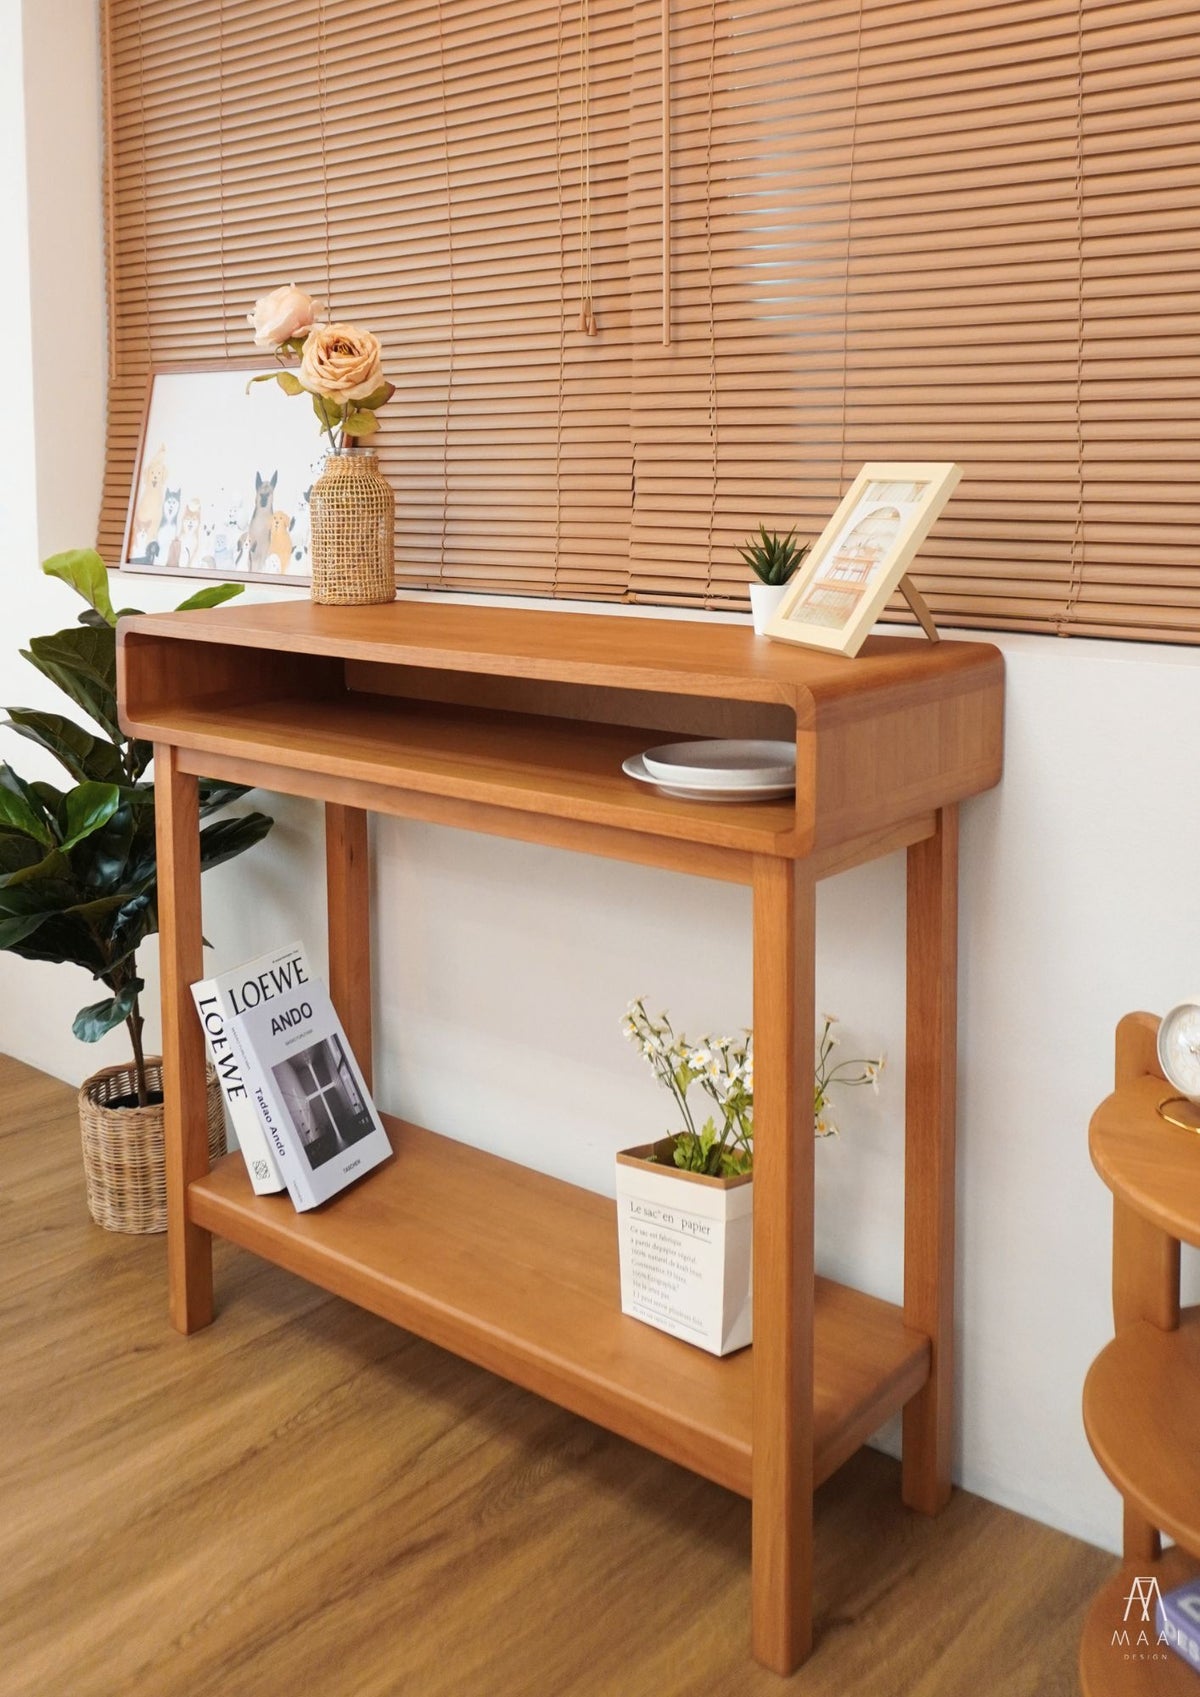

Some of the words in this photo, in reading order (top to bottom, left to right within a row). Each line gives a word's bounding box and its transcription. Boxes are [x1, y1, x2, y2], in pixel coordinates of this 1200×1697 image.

[228, 957, 309, 1016] LOEWE
[271, 1002, 313, 1036] ANDO
[198, 996, 248, 1103] LOEWE
[254, 1087, 272, 1123] Tadao
[269, 1125, 286, 1157] Ando
[630, 1201, 642, 1214] Le
[662, 1213, 674, 1223] en
[681, 1218, 711, 1236] papier
